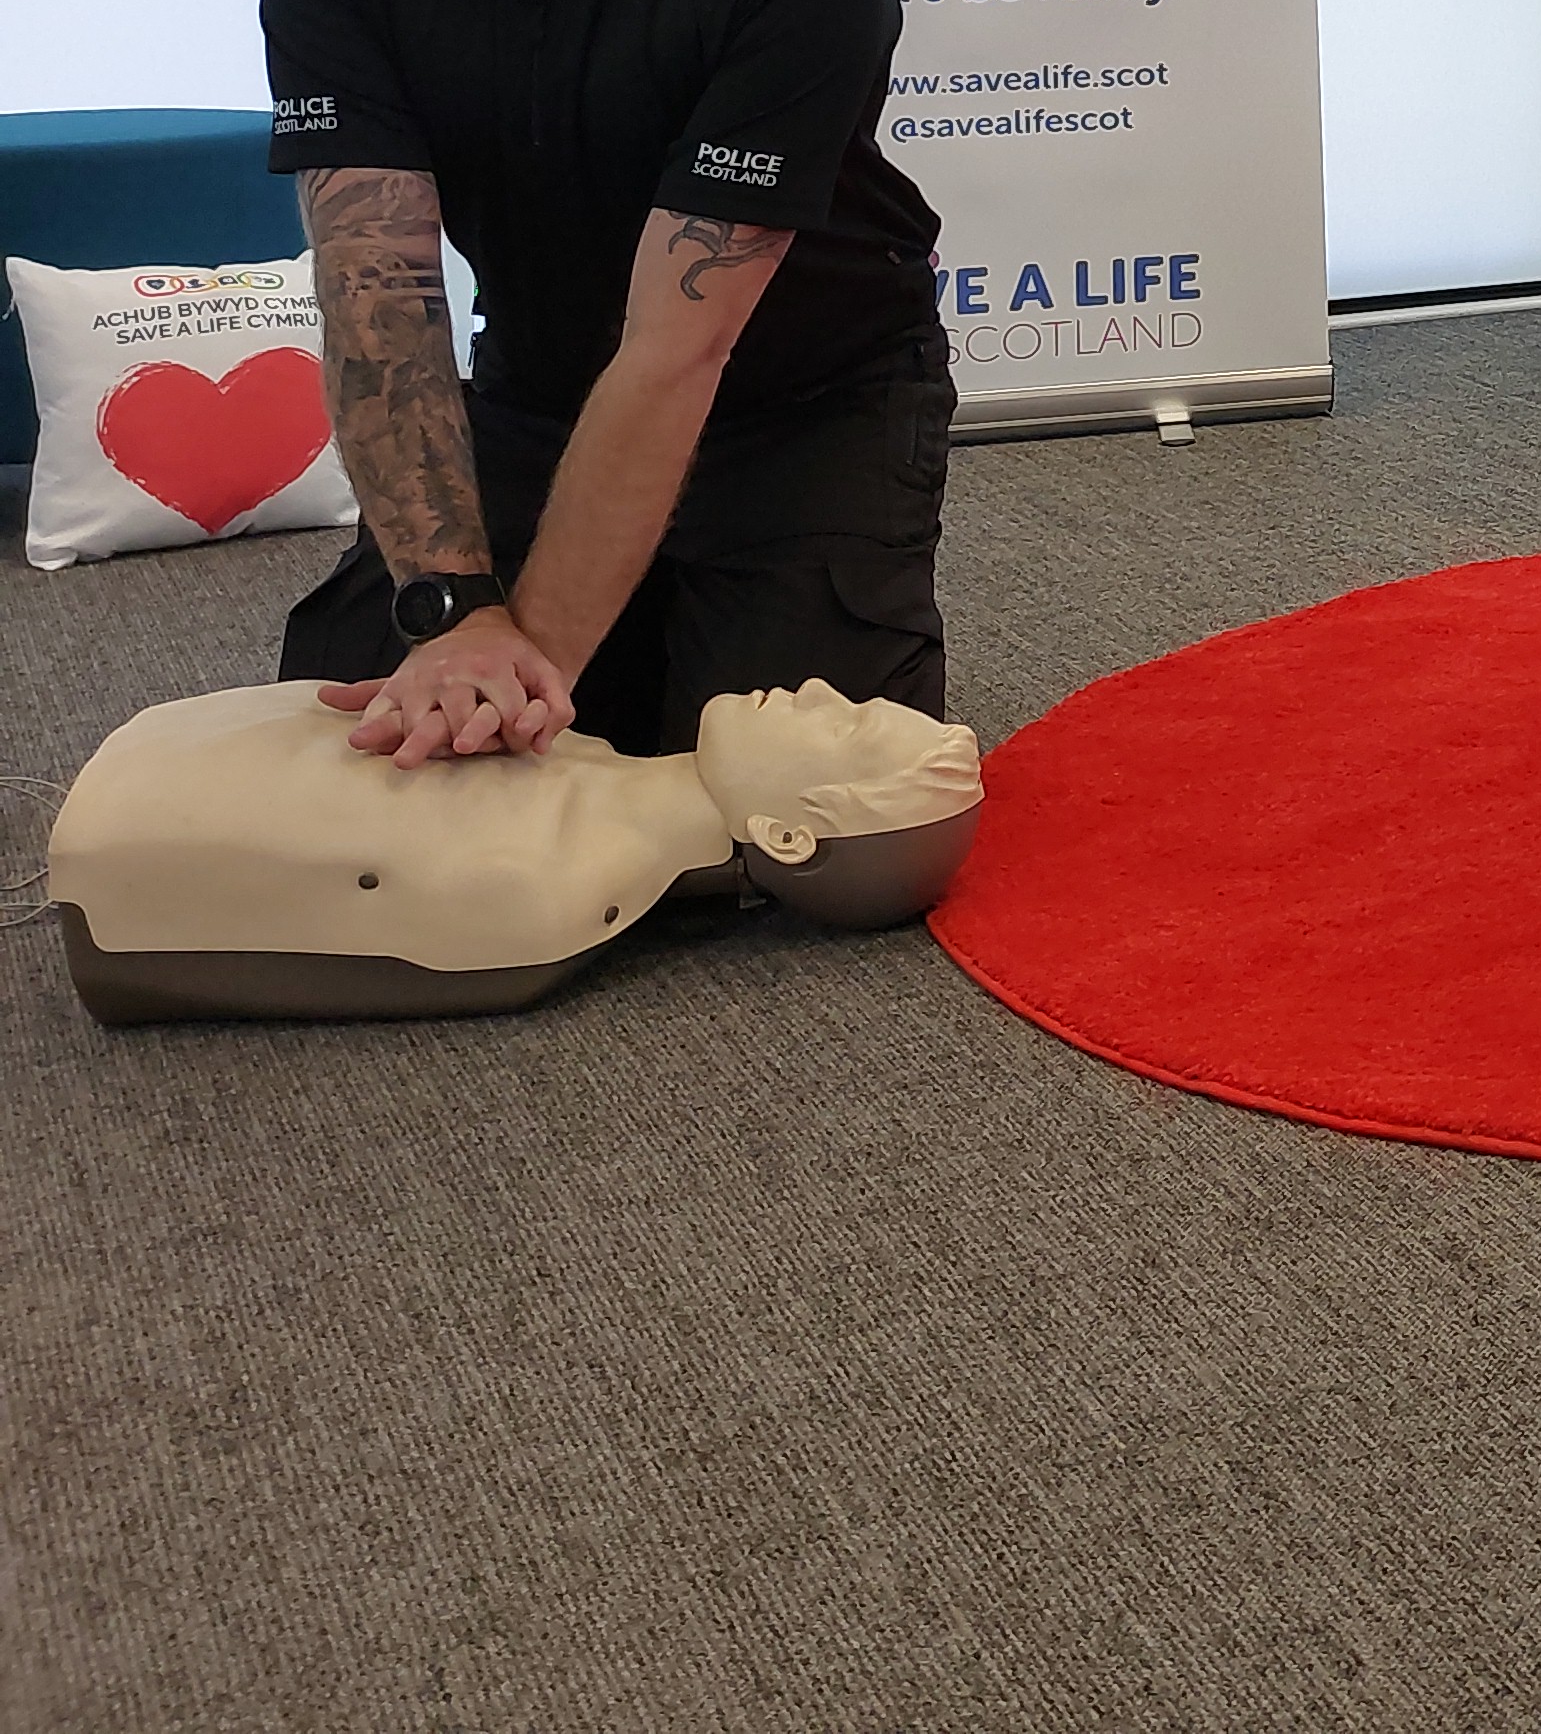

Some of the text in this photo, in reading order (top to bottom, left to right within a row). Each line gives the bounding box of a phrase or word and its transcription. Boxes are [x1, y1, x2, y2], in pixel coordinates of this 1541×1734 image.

[887, 62, 1170, 96] ww.savealife.scot
[891, 106, 1135, 144] @savealifescot
[690, 161, 777, 187] SCOTLAND
[698, 142, 785, 173] POLICE
[1009, 263, 1055, 312] A
[1076, 254, 1201, 307] LIFE
[92, 295, 318, 331] ACHUB BYWYD CYMR
[115, 312, 319, 345] SAVE A LIFE CYMRU
